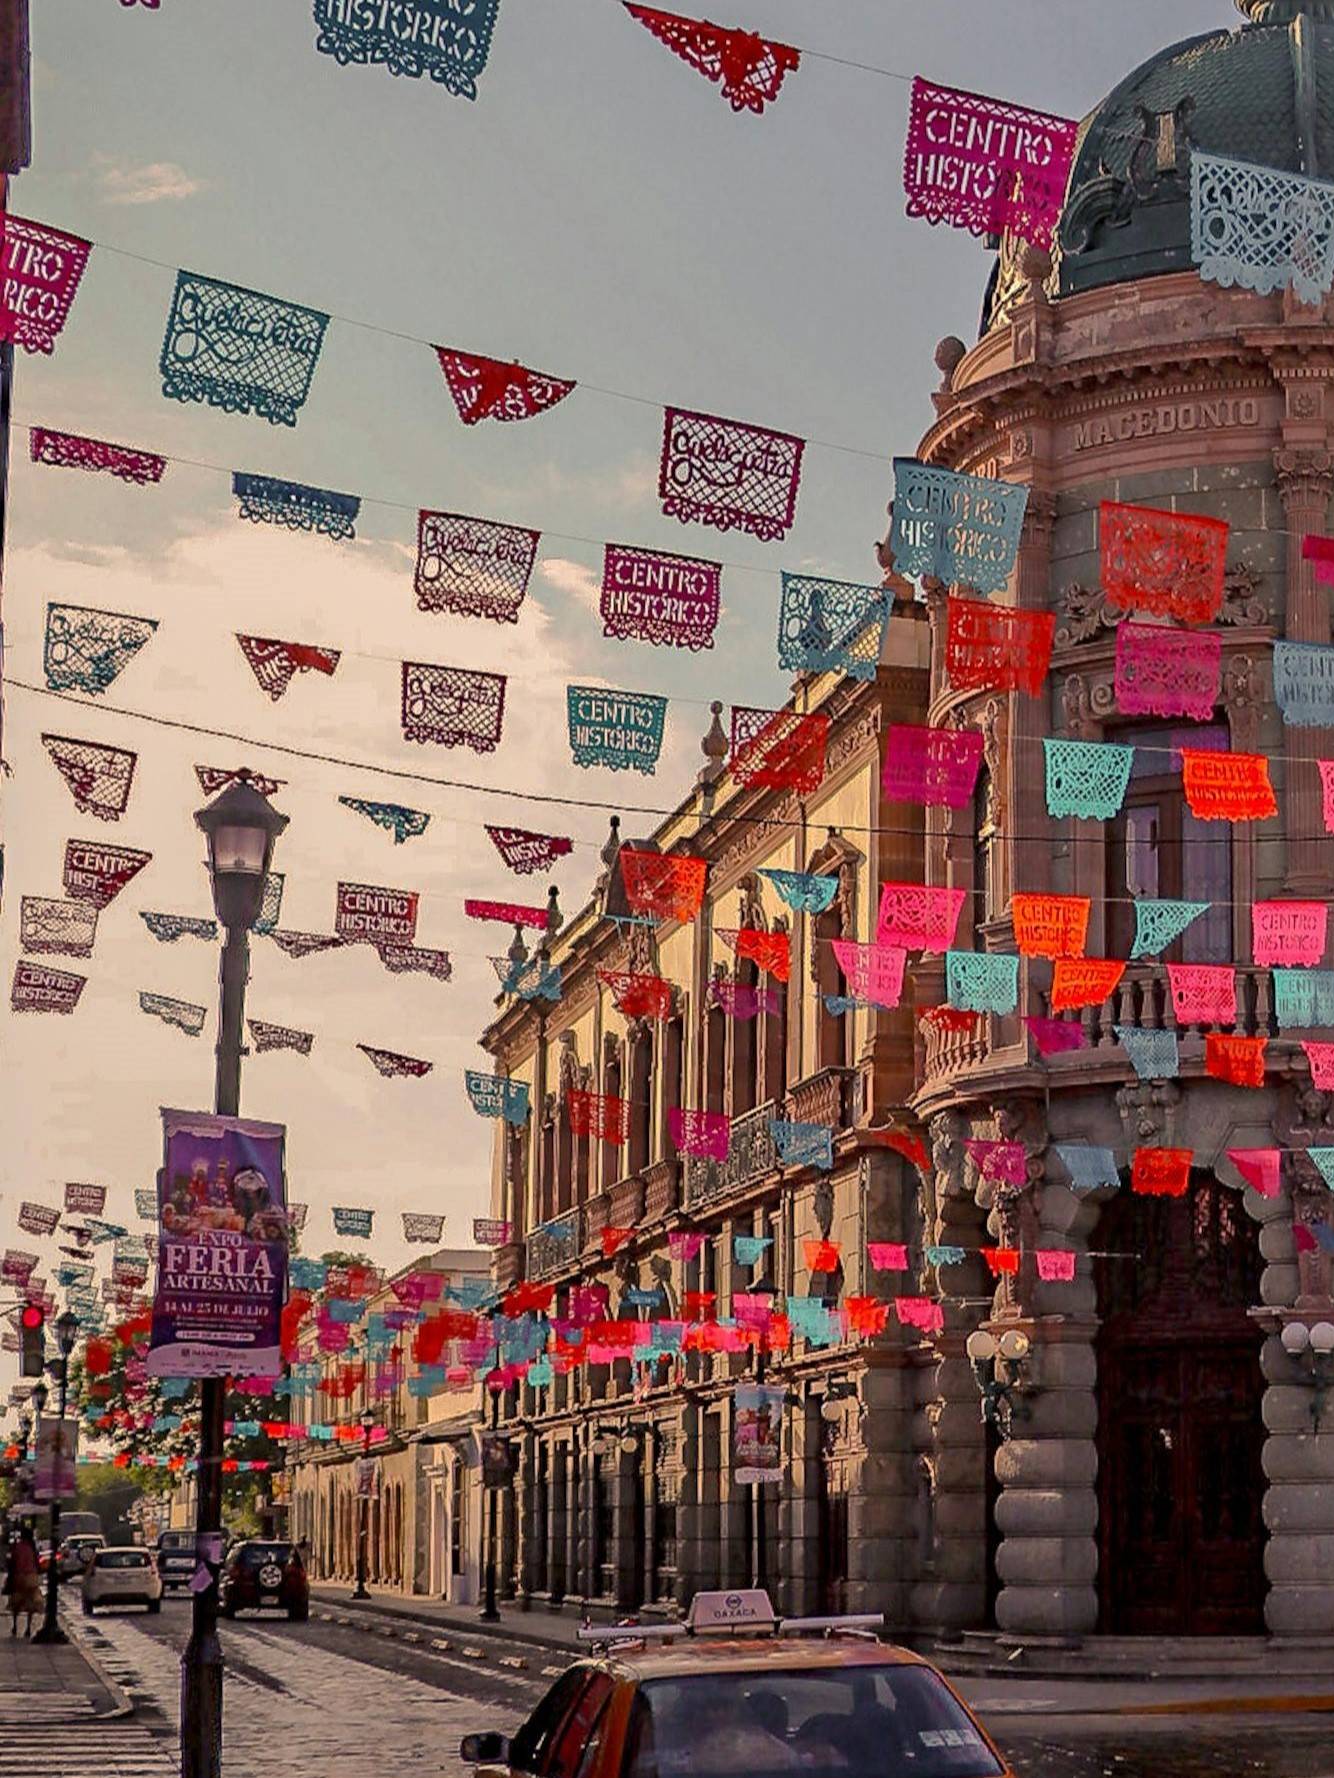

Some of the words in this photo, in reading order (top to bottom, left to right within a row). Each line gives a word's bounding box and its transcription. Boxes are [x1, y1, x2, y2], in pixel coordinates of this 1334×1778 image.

[926, 108, 1053, 166] CENTRO
[1074, 400, 1259, 451] MACEDONIO
[614, 558, 707, 596] CENTRO
[609, 591, 710, 626] HISTÓRICO
[577, 700, 653, 729] CENTRO
[344, 893, 408, 914] CENTRO
[1021, 904, 1080, 922] CENTRO
[198, 1232, 242, 1247] EXPO
[164, 1243, 275, 1278] FERIA
[164, 1273, 274, 1294] ARTESANAL
[714, 1608, 757, 1619] OAXACA
